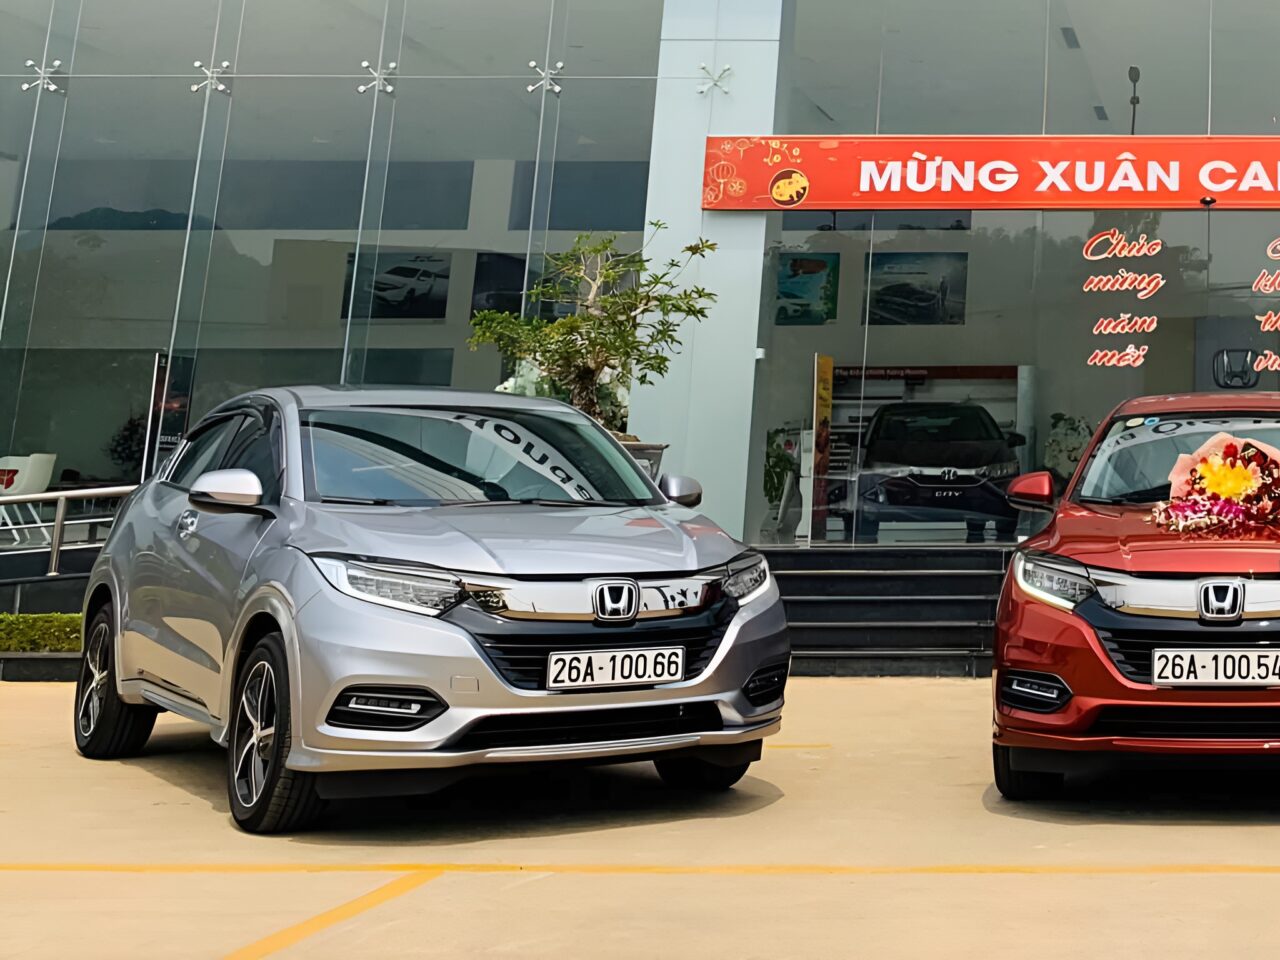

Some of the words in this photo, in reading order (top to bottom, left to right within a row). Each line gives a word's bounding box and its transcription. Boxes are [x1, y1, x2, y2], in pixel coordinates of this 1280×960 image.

[859, 151, 1019, 192] MỪNG
[1035, 151, 1180, 192] XUÂN
[1082, 227, 1162, 260] Chúc
[1082, 268, 1166, 299] mừng
[1092, 312, 1158, 335] năm
[552, 651, 680, 684] 26A-100.66
